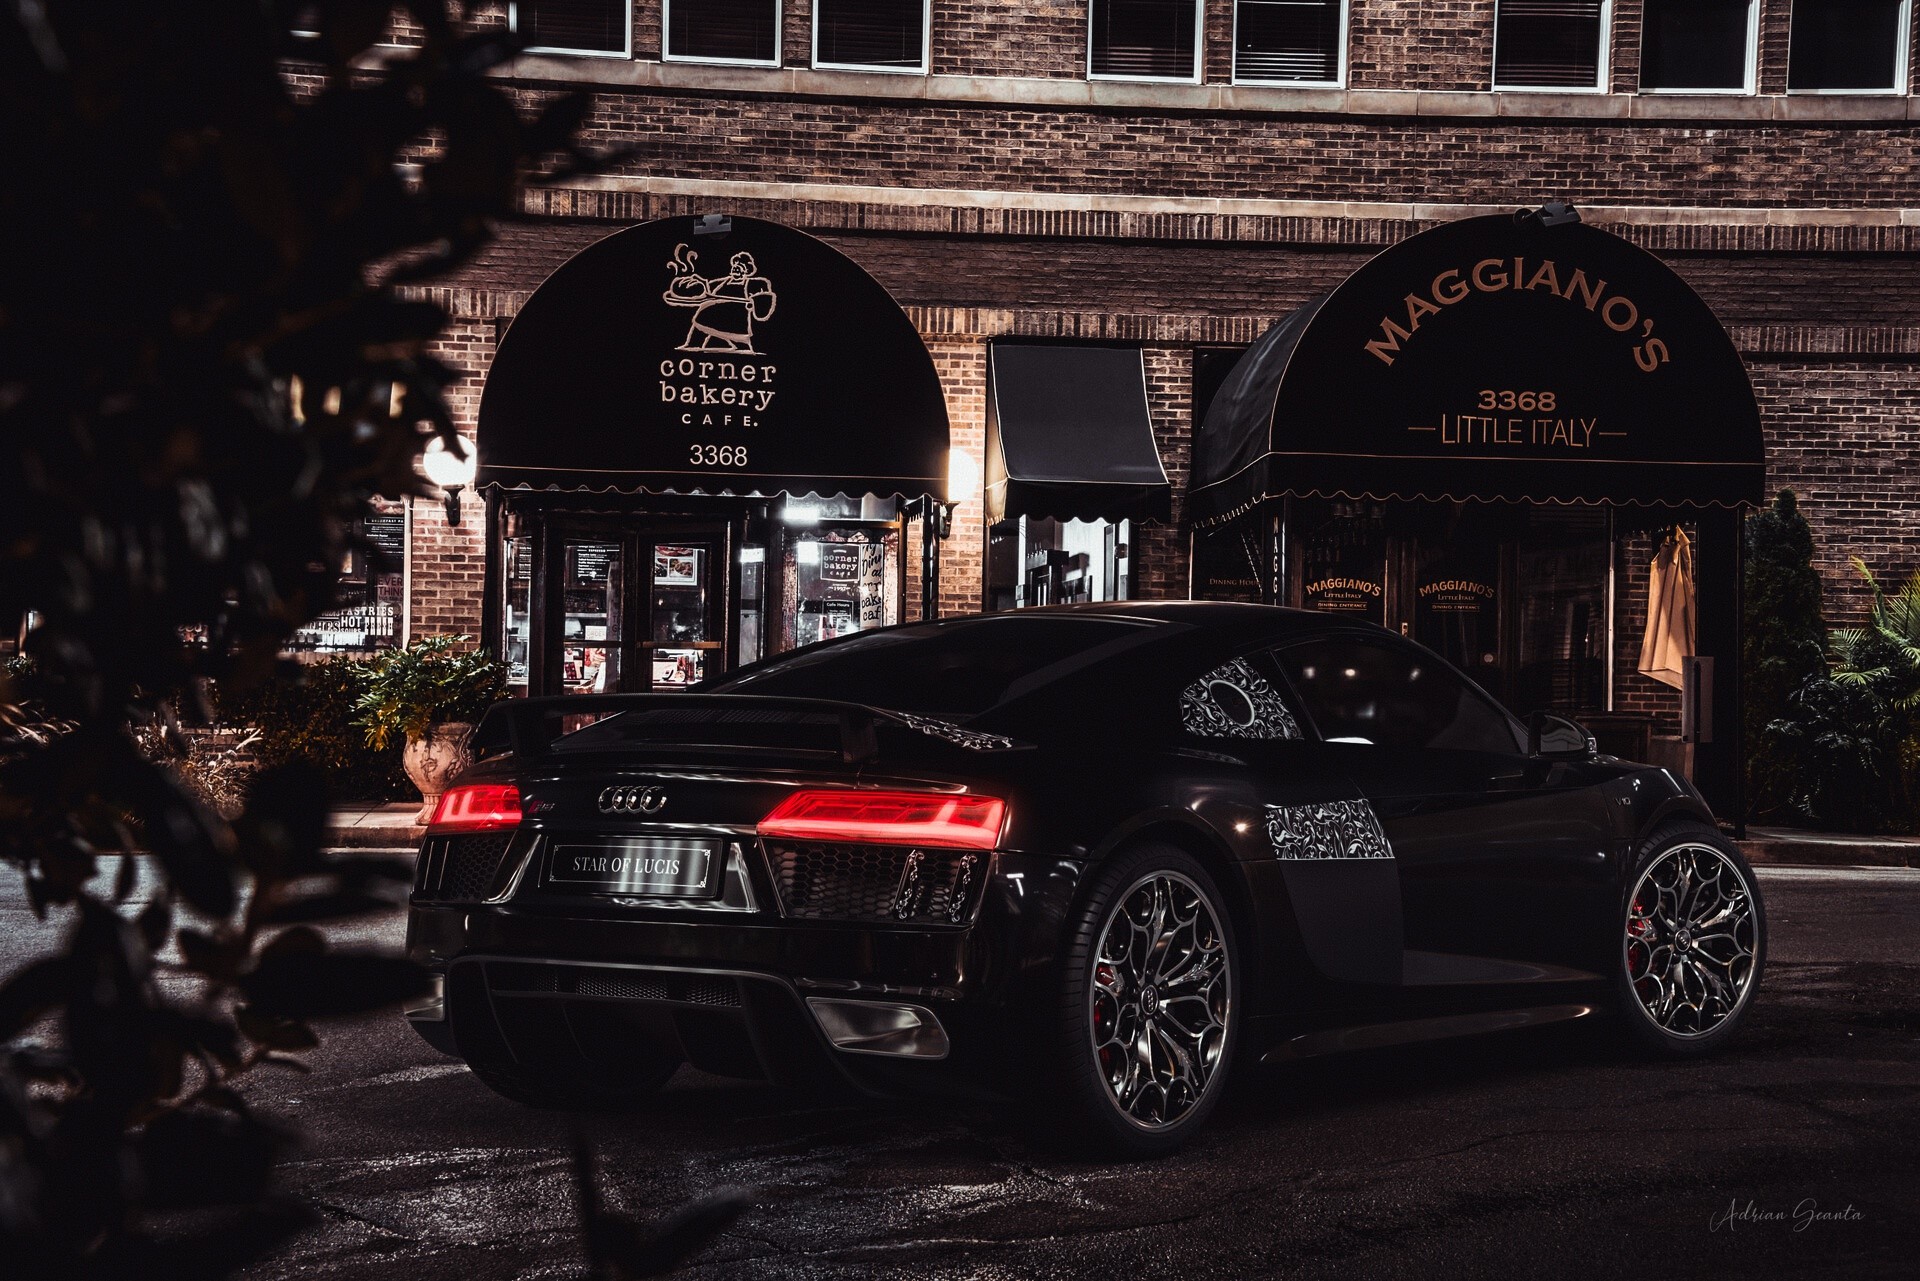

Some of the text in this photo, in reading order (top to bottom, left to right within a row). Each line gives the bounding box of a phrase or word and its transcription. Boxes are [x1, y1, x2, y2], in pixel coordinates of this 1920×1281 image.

[1364, 257, 1671, 373] MAGGIANO'S
[660, 357, 777, 383] corner
[660, 381, 776, 411] bakery
[1477, 389, 1557, 411] 3368
[1441, 414, 1597, 447] LITTLE ITALY
[689, 444, 748, 467] 3368
[823, 555, 858, 563] corner
[823, 562, 858, 571] bakery
[1305, 578, 1382, 597] MAGGIANO'S
[1345, 591, 1362, 599] ITALY
[1418, 580, 1495, 599] MAGGIANO'S
[341, 606, 394, 616] PASTRIES
[341, 616, 362, 627] HOT
[572, 856, 680, 875] STAR OF LUCIS
